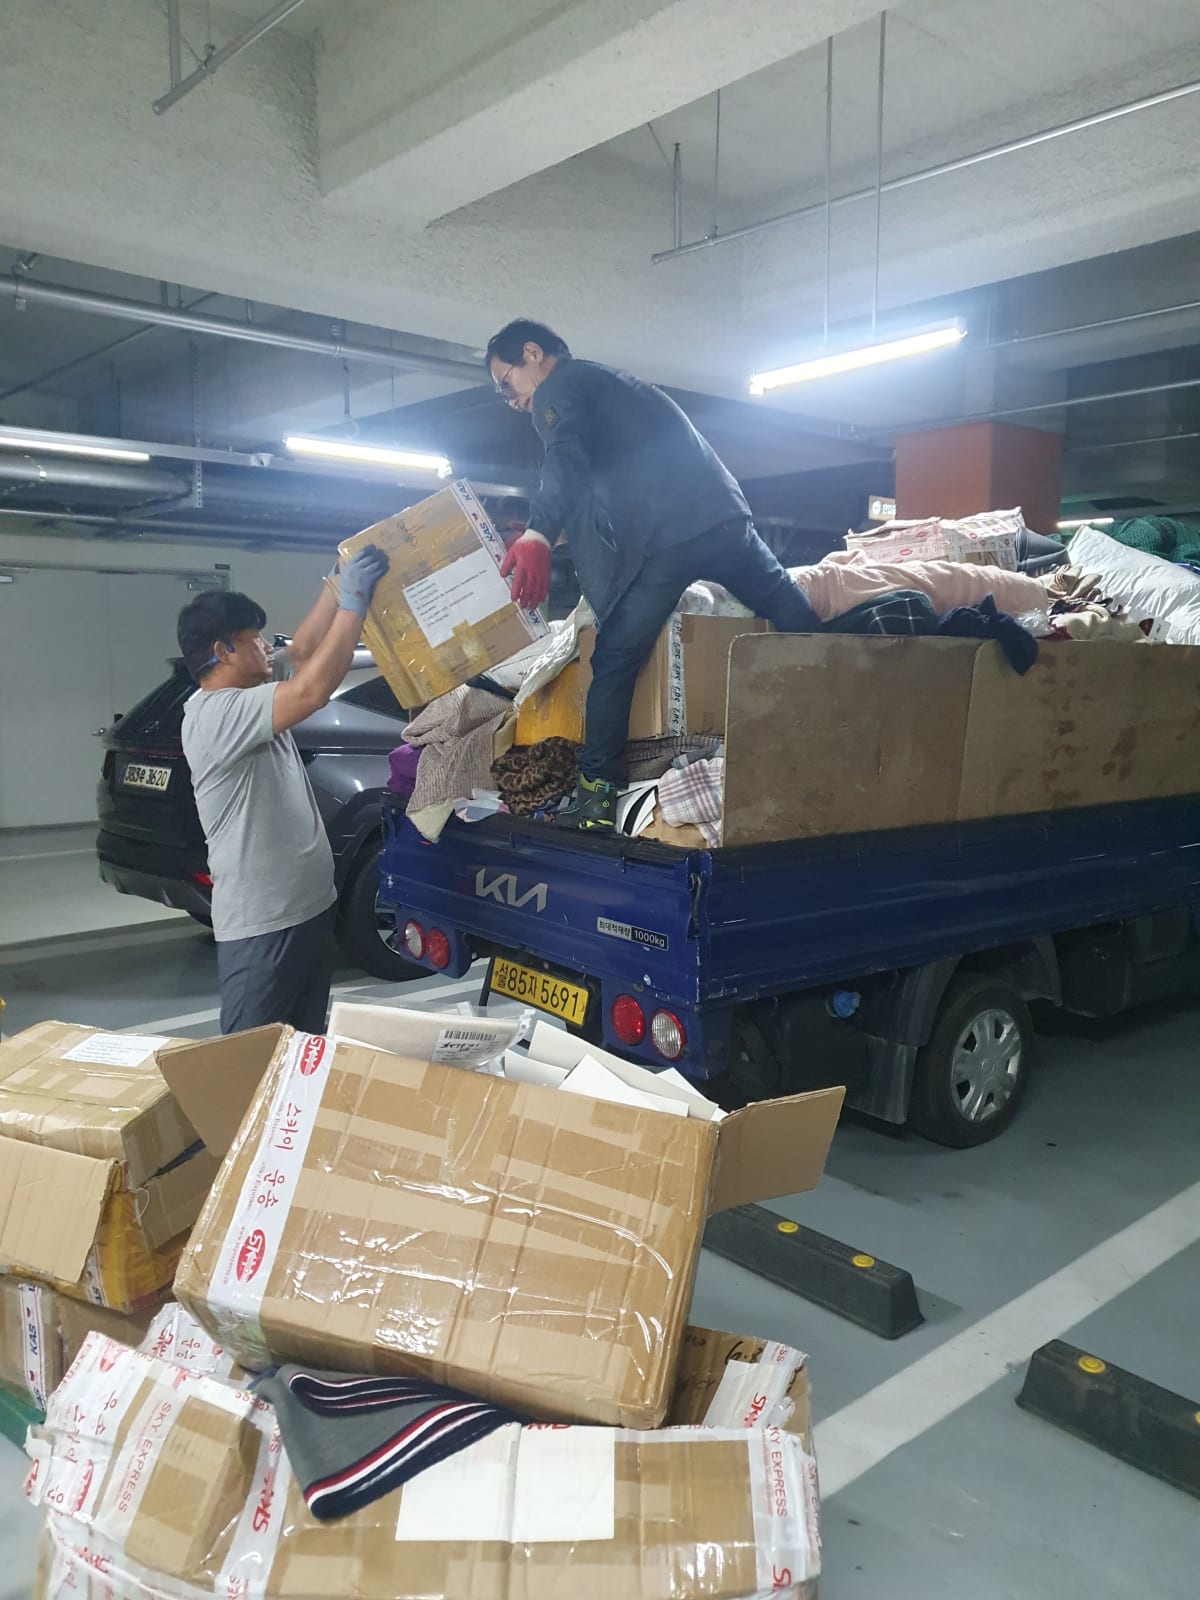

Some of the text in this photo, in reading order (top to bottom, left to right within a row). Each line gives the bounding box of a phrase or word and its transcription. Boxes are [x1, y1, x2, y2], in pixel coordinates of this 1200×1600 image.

[456, 481, 473, 500] KAS
[479, 522, 496, 542] KAS
[475, 868, 548, 913] KIA
[633, 929, 665, 948] 1000kg
[507, 967, 538, 999] 85자
[540, 978, 579, 1017] 5691
[274, 1102, 303, 1151] 스카이
[257, 1169, 286, 1209] 운송
[28, 1323, 38, 1355] KAS
[149, 1401, 173, 1433] SKY
[117, 1438, 153, 1513] EXPRESS
[771, 1450, 789, 1518] EXPRESS
